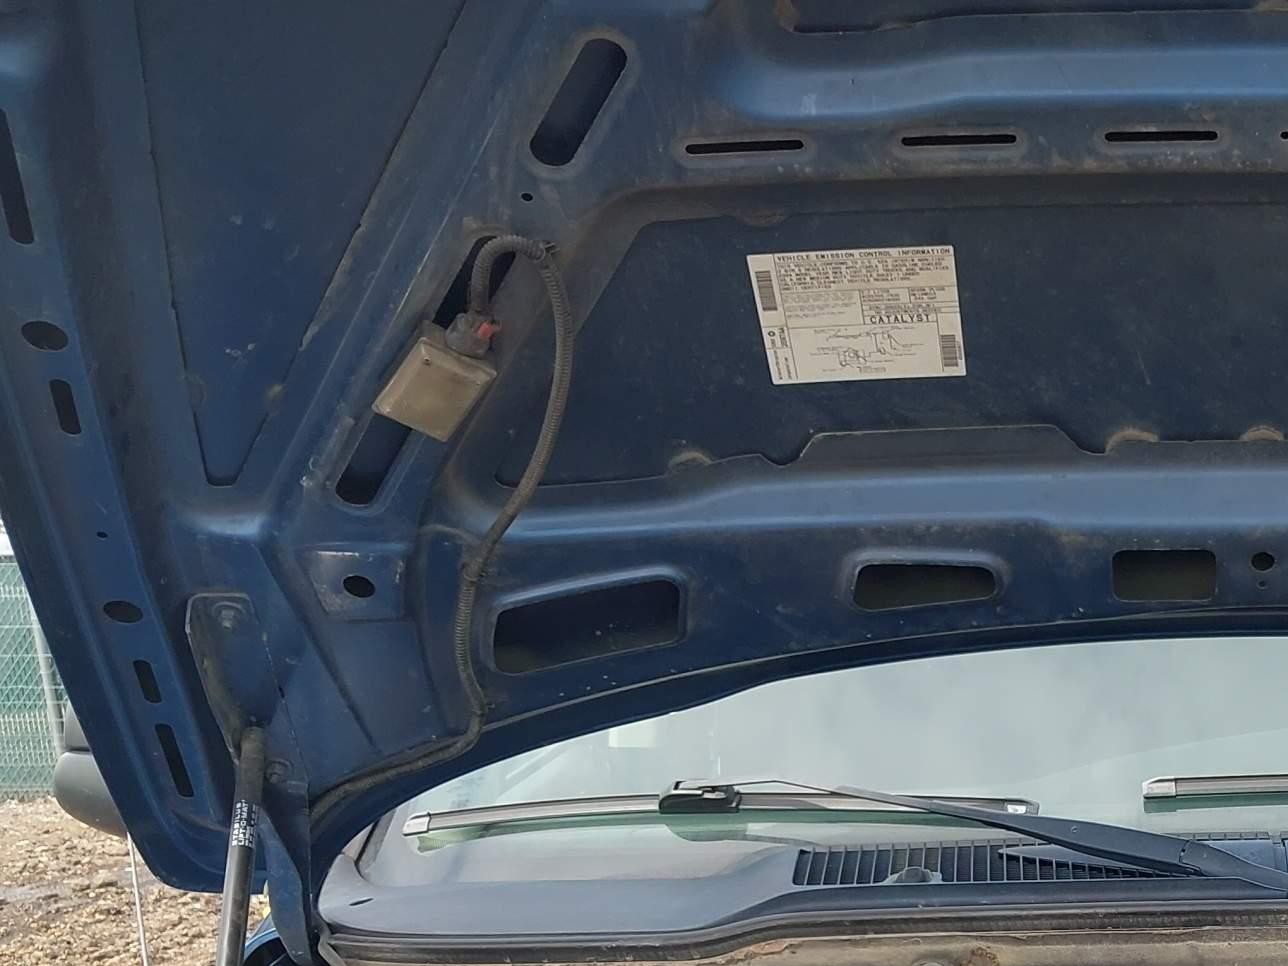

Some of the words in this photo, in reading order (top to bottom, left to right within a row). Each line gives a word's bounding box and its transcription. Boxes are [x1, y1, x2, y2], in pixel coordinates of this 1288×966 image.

[777, 253, 810, 262] VEHICLE
[816, 251, 854, 260] EMISSION
[859, 250, 892, 259] CONTROL
[898, 248, 951, 256] INFORMATION
[870, 313, 930, 324] CATALYST
